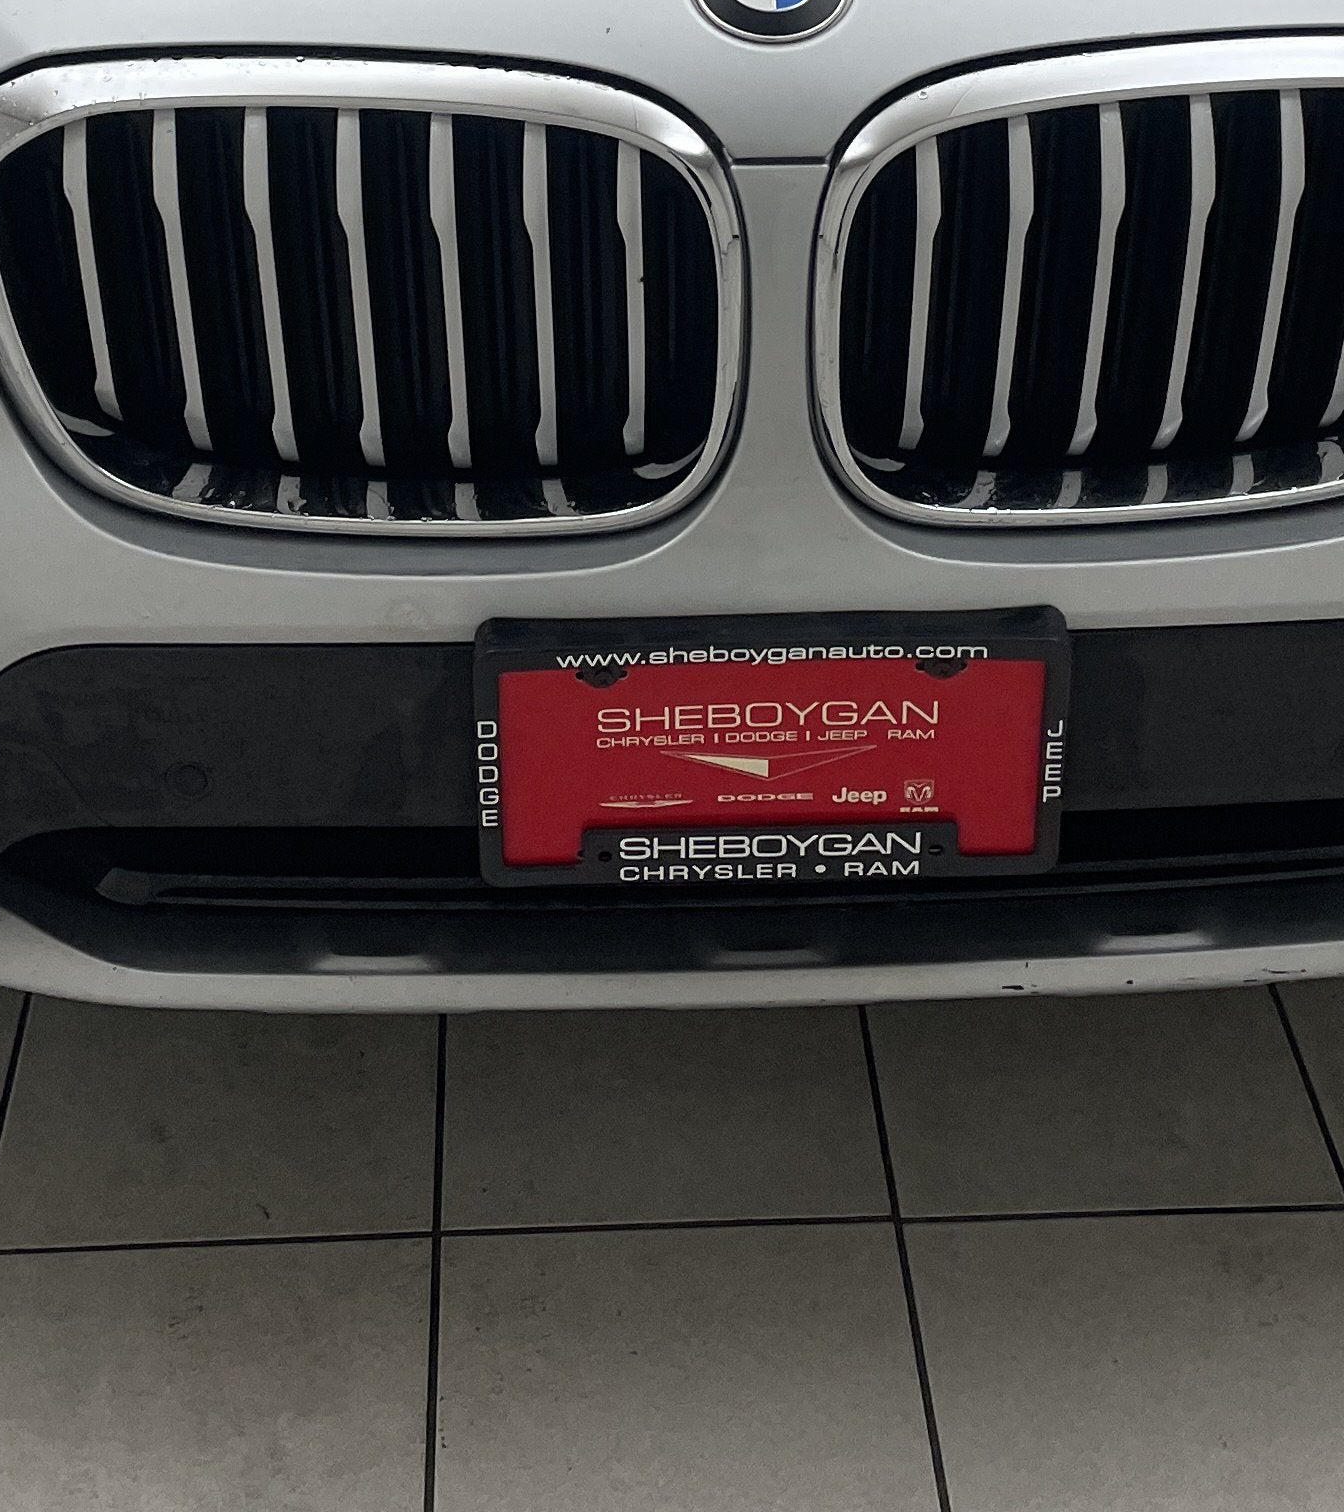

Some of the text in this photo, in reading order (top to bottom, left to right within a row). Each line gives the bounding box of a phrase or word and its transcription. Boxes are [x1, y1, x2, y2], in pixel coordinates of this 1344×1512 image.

[555, 644, 988, 668] www.sheboyganauto.com
[597, 700, 939, 733] SHEBOYGAN
[596, 733, 705, 749] CHRYSLER
[725, 730, 798, 744] DODGE
[817, 729, 868, 741] JEEP
[887, 729, 935, 740] RAM
[1042, 719, 1064, 803] JEEP
[477, 720, 500, 827] DODGE
[717, 792, 814, 803] DODGE
[831, 786, 888, 806] Jeep
[619, 831, 922, 861] SHEBOYGAN
[619, 860, 920, 881] CHRYSLER RAM
